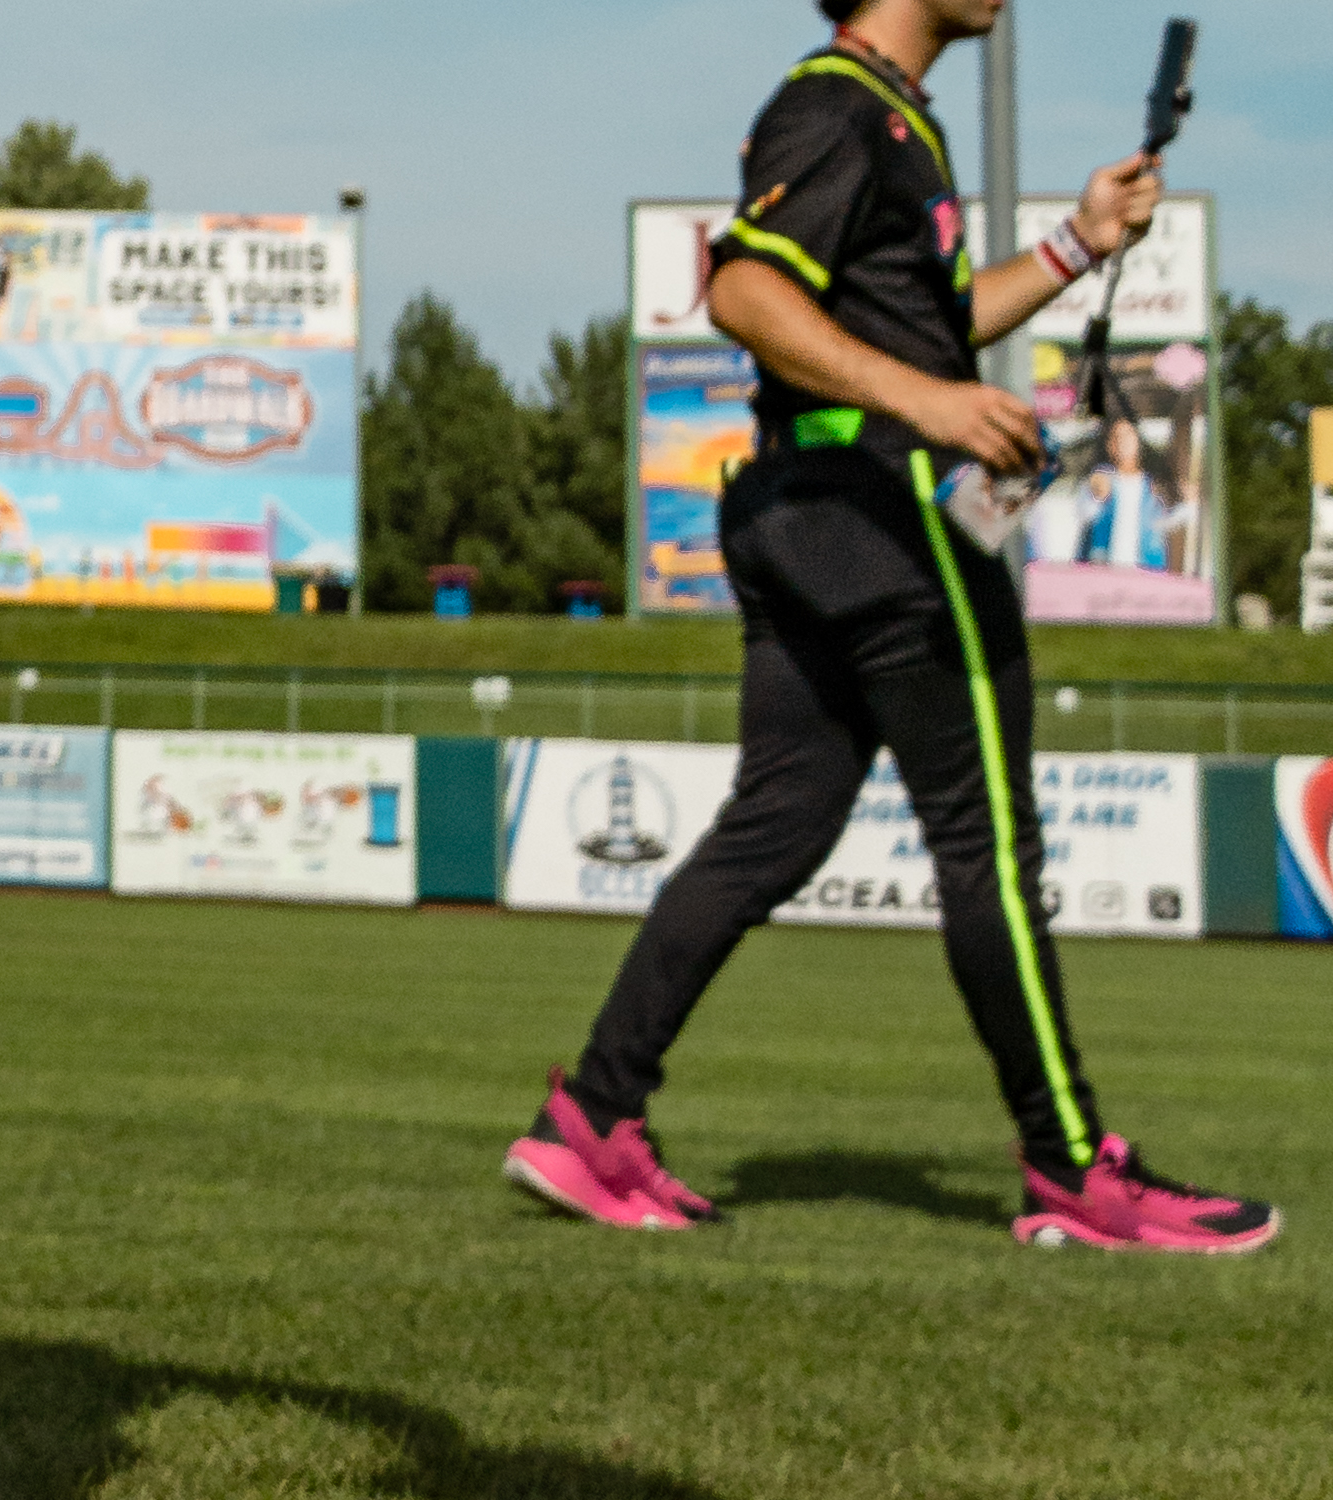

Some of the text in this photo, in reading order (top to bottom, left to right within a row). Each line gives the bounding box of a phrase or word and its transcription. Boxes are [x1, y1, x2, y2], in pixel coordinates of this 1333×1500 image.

[120, 239, 226, 272] MAKE
[243, 240, 328, 273] THIS
[108, 278, 207, 308] SPACE
